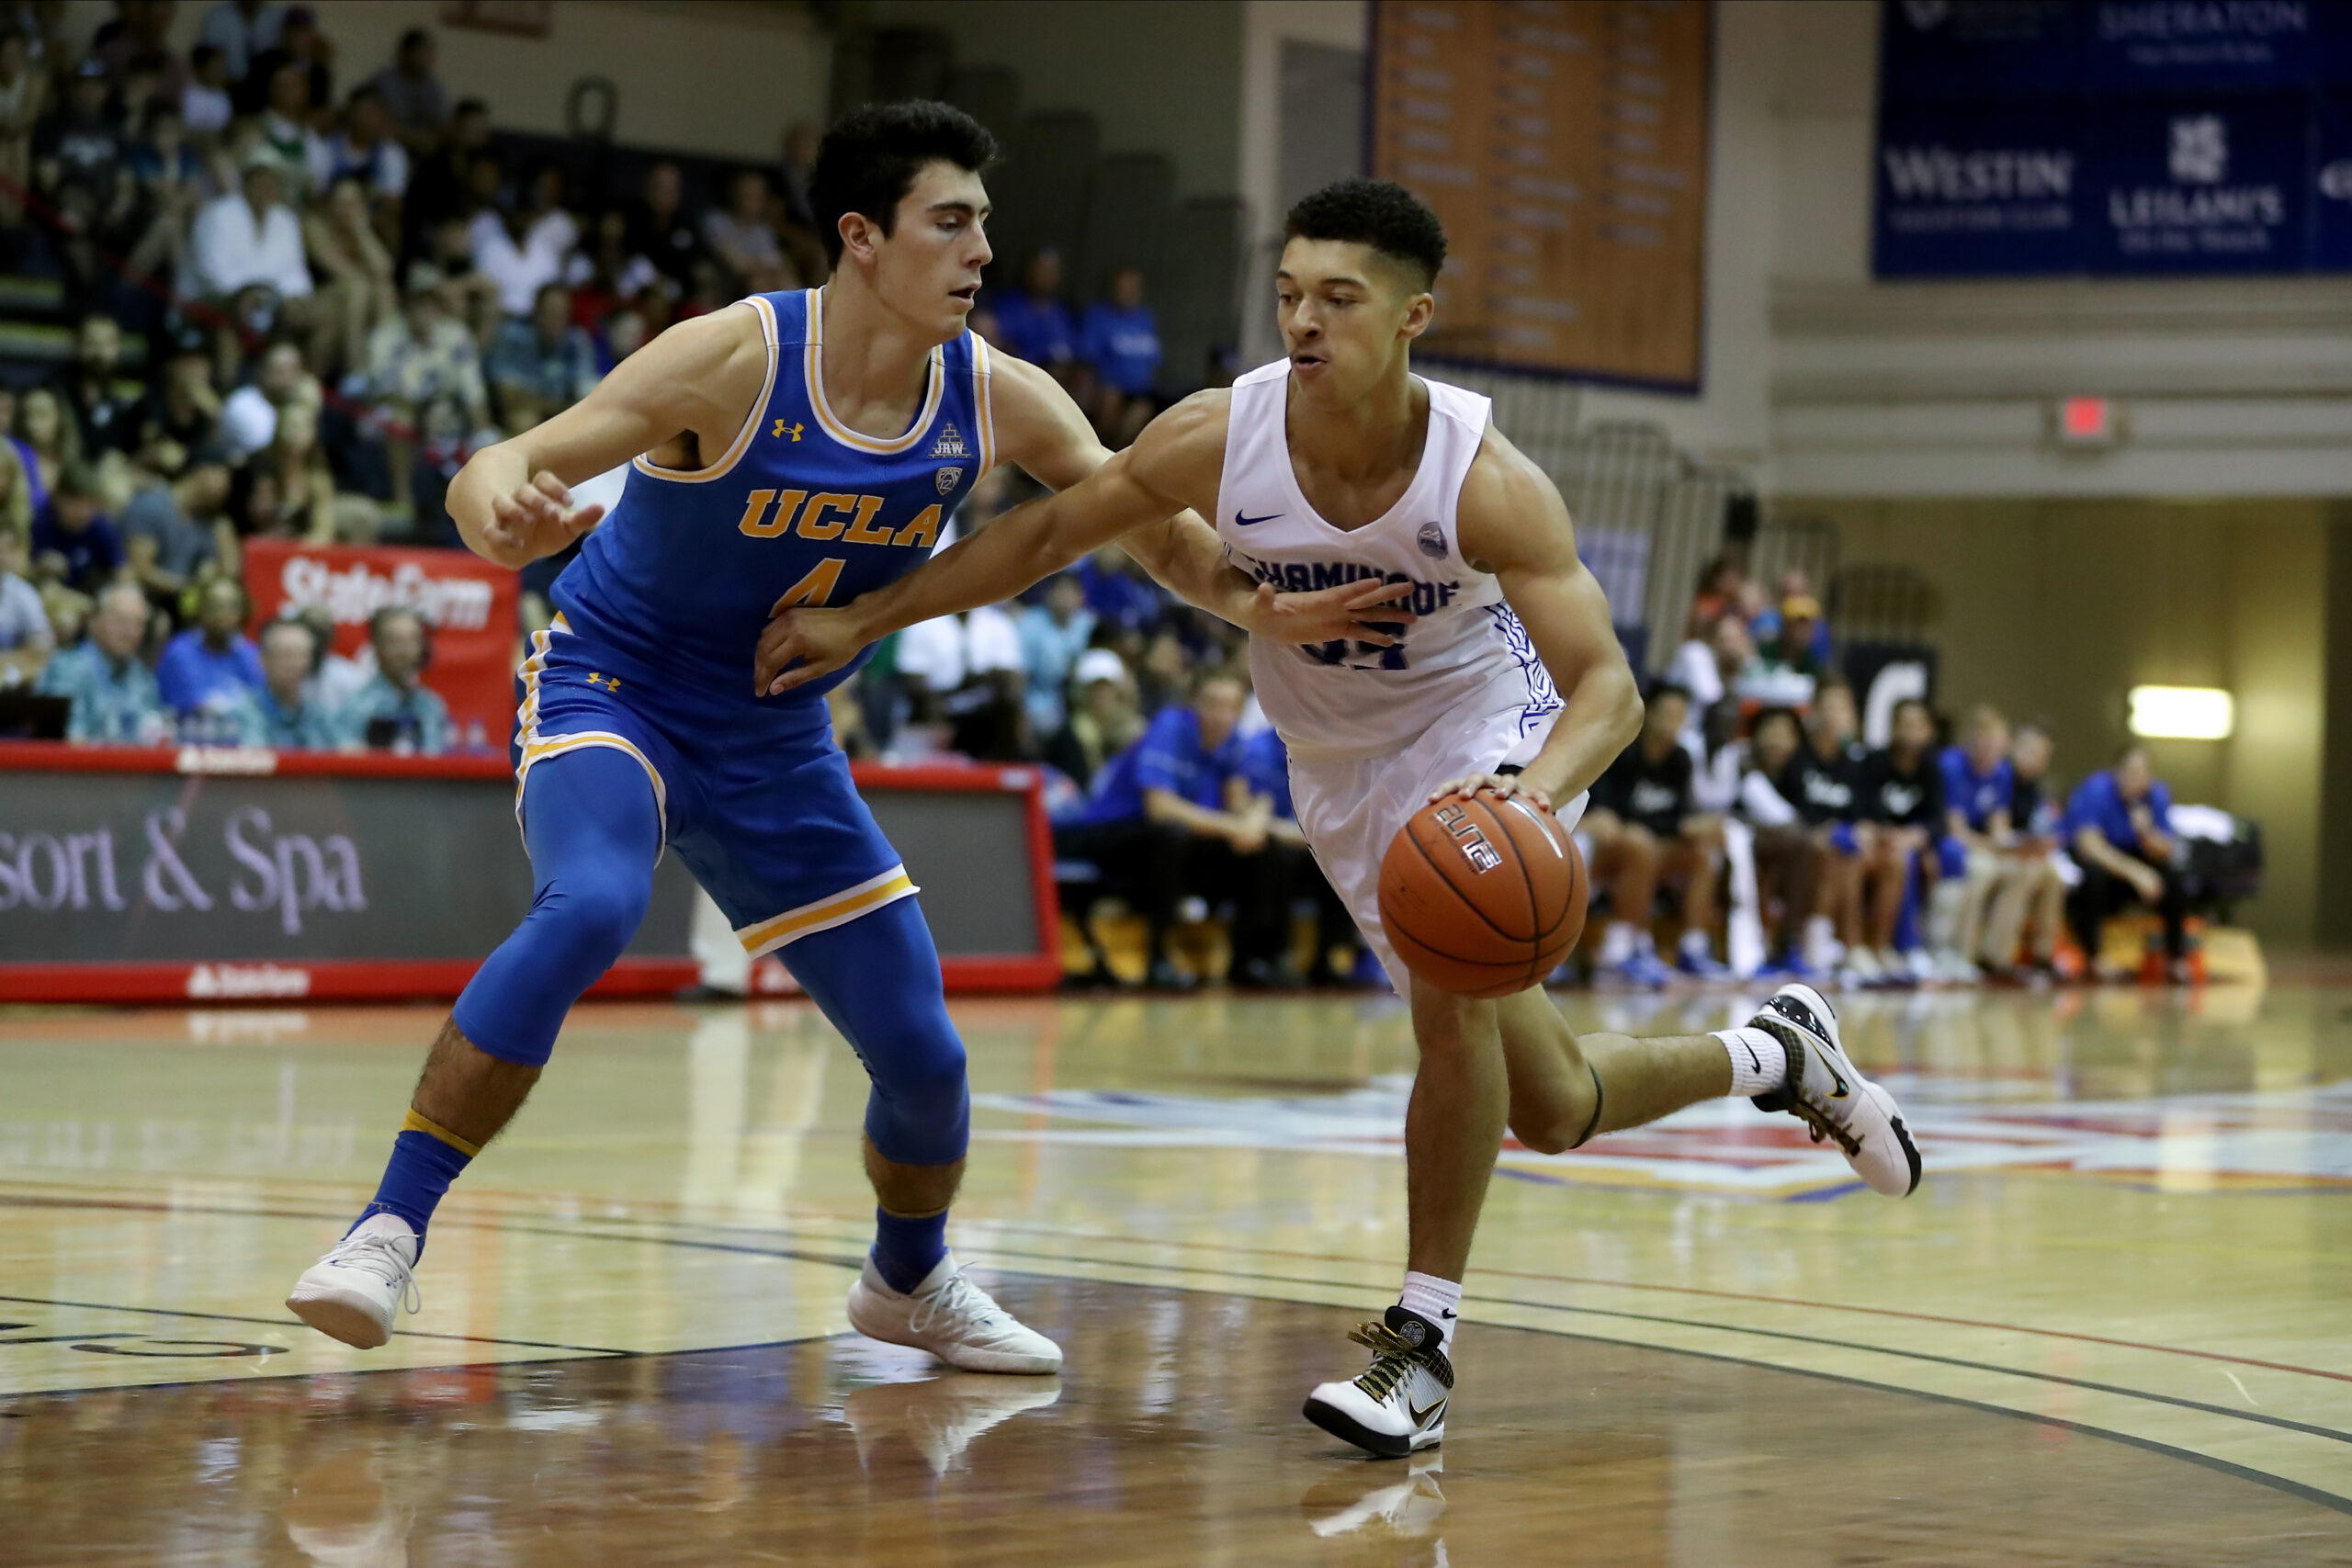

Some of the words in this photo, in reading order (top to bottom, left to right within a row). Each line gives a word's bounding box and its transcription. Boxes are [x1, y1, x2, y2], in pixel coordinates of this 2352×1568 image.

[2098, 1, 2308, 40] SHERATON
[1885, 146, 2073, 198] WESTIN
[934, 443, 964, 455] JRW
[738, 489, 943, 547] UCLA
[767, 557, 847, 619] 4
[1434, 803, 1503, 874] ELITE
[144, 806, 214, 912] &
[225, 804, 367, 935] Spa
